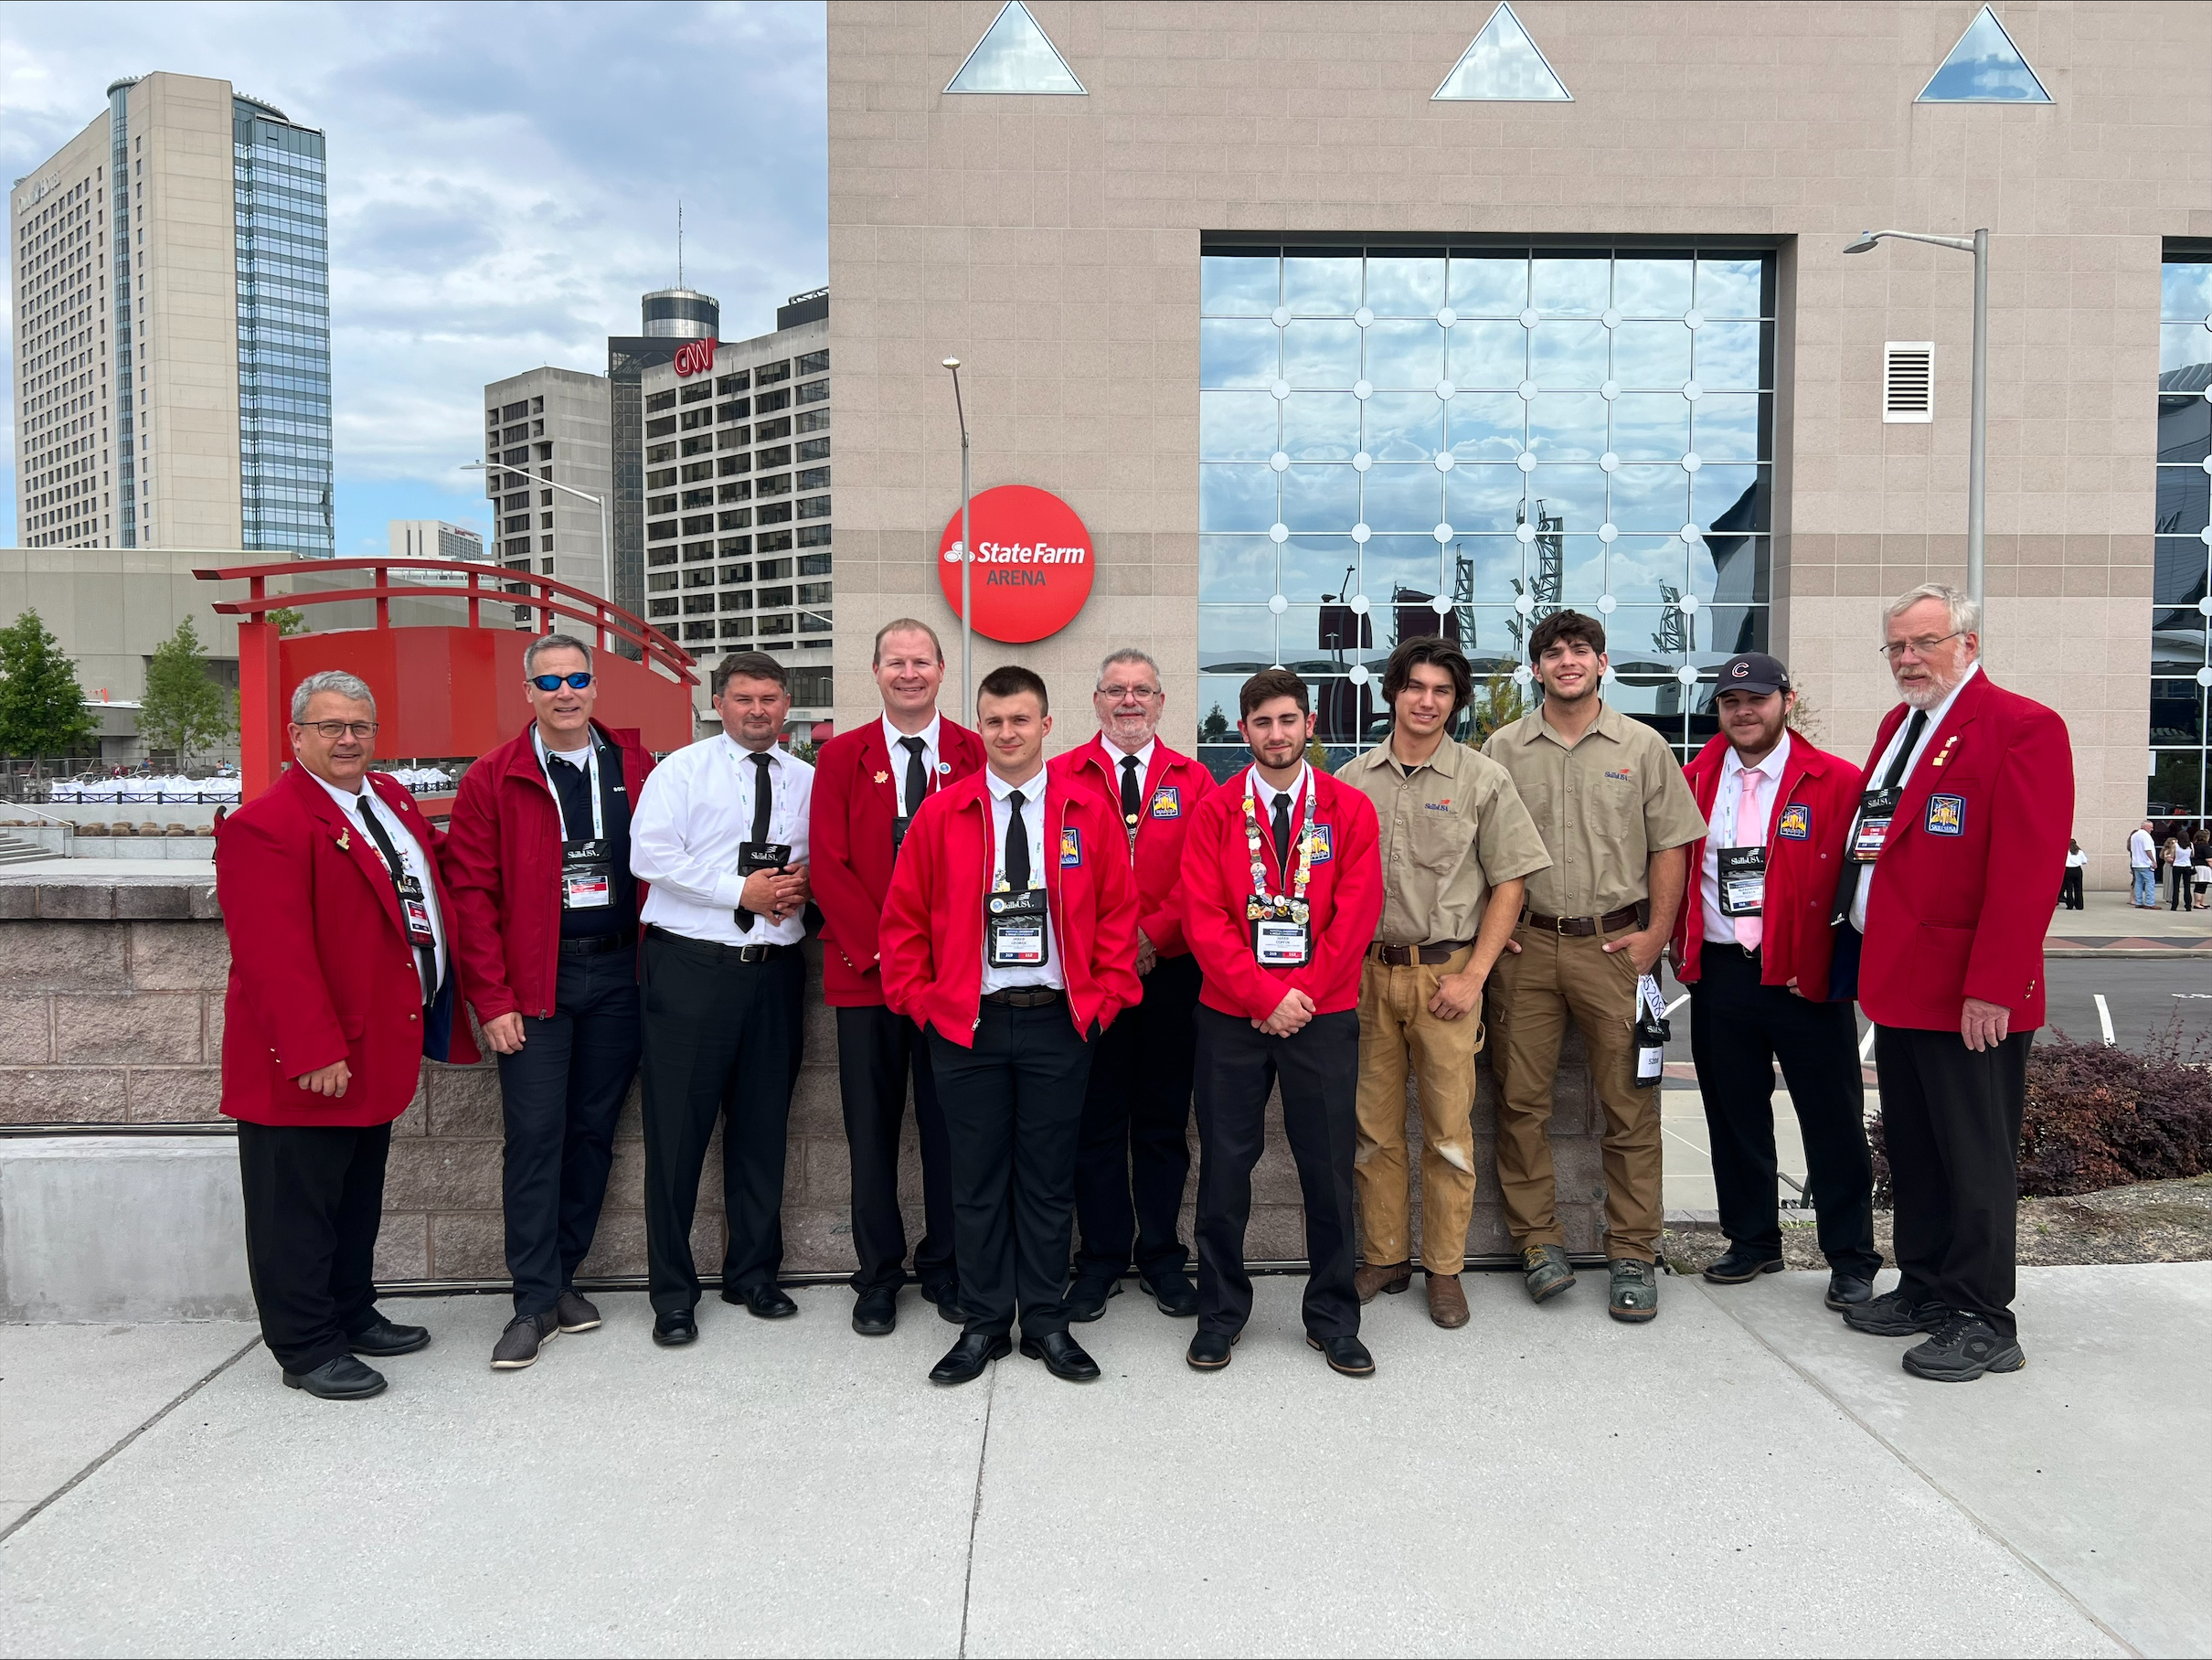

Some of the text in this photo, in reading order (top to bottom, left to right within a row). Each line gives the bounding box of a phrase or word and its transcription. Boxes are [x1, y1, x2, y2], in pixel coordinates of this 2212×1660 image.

[674, 337, 717, 378] CNN
[977, 541, 1085, 564] State Farm
[986, 569, 1047, 586] ARENA
[1732, 662, 1749, 677] C
[1643, 977, 1664, 1016] 5208
